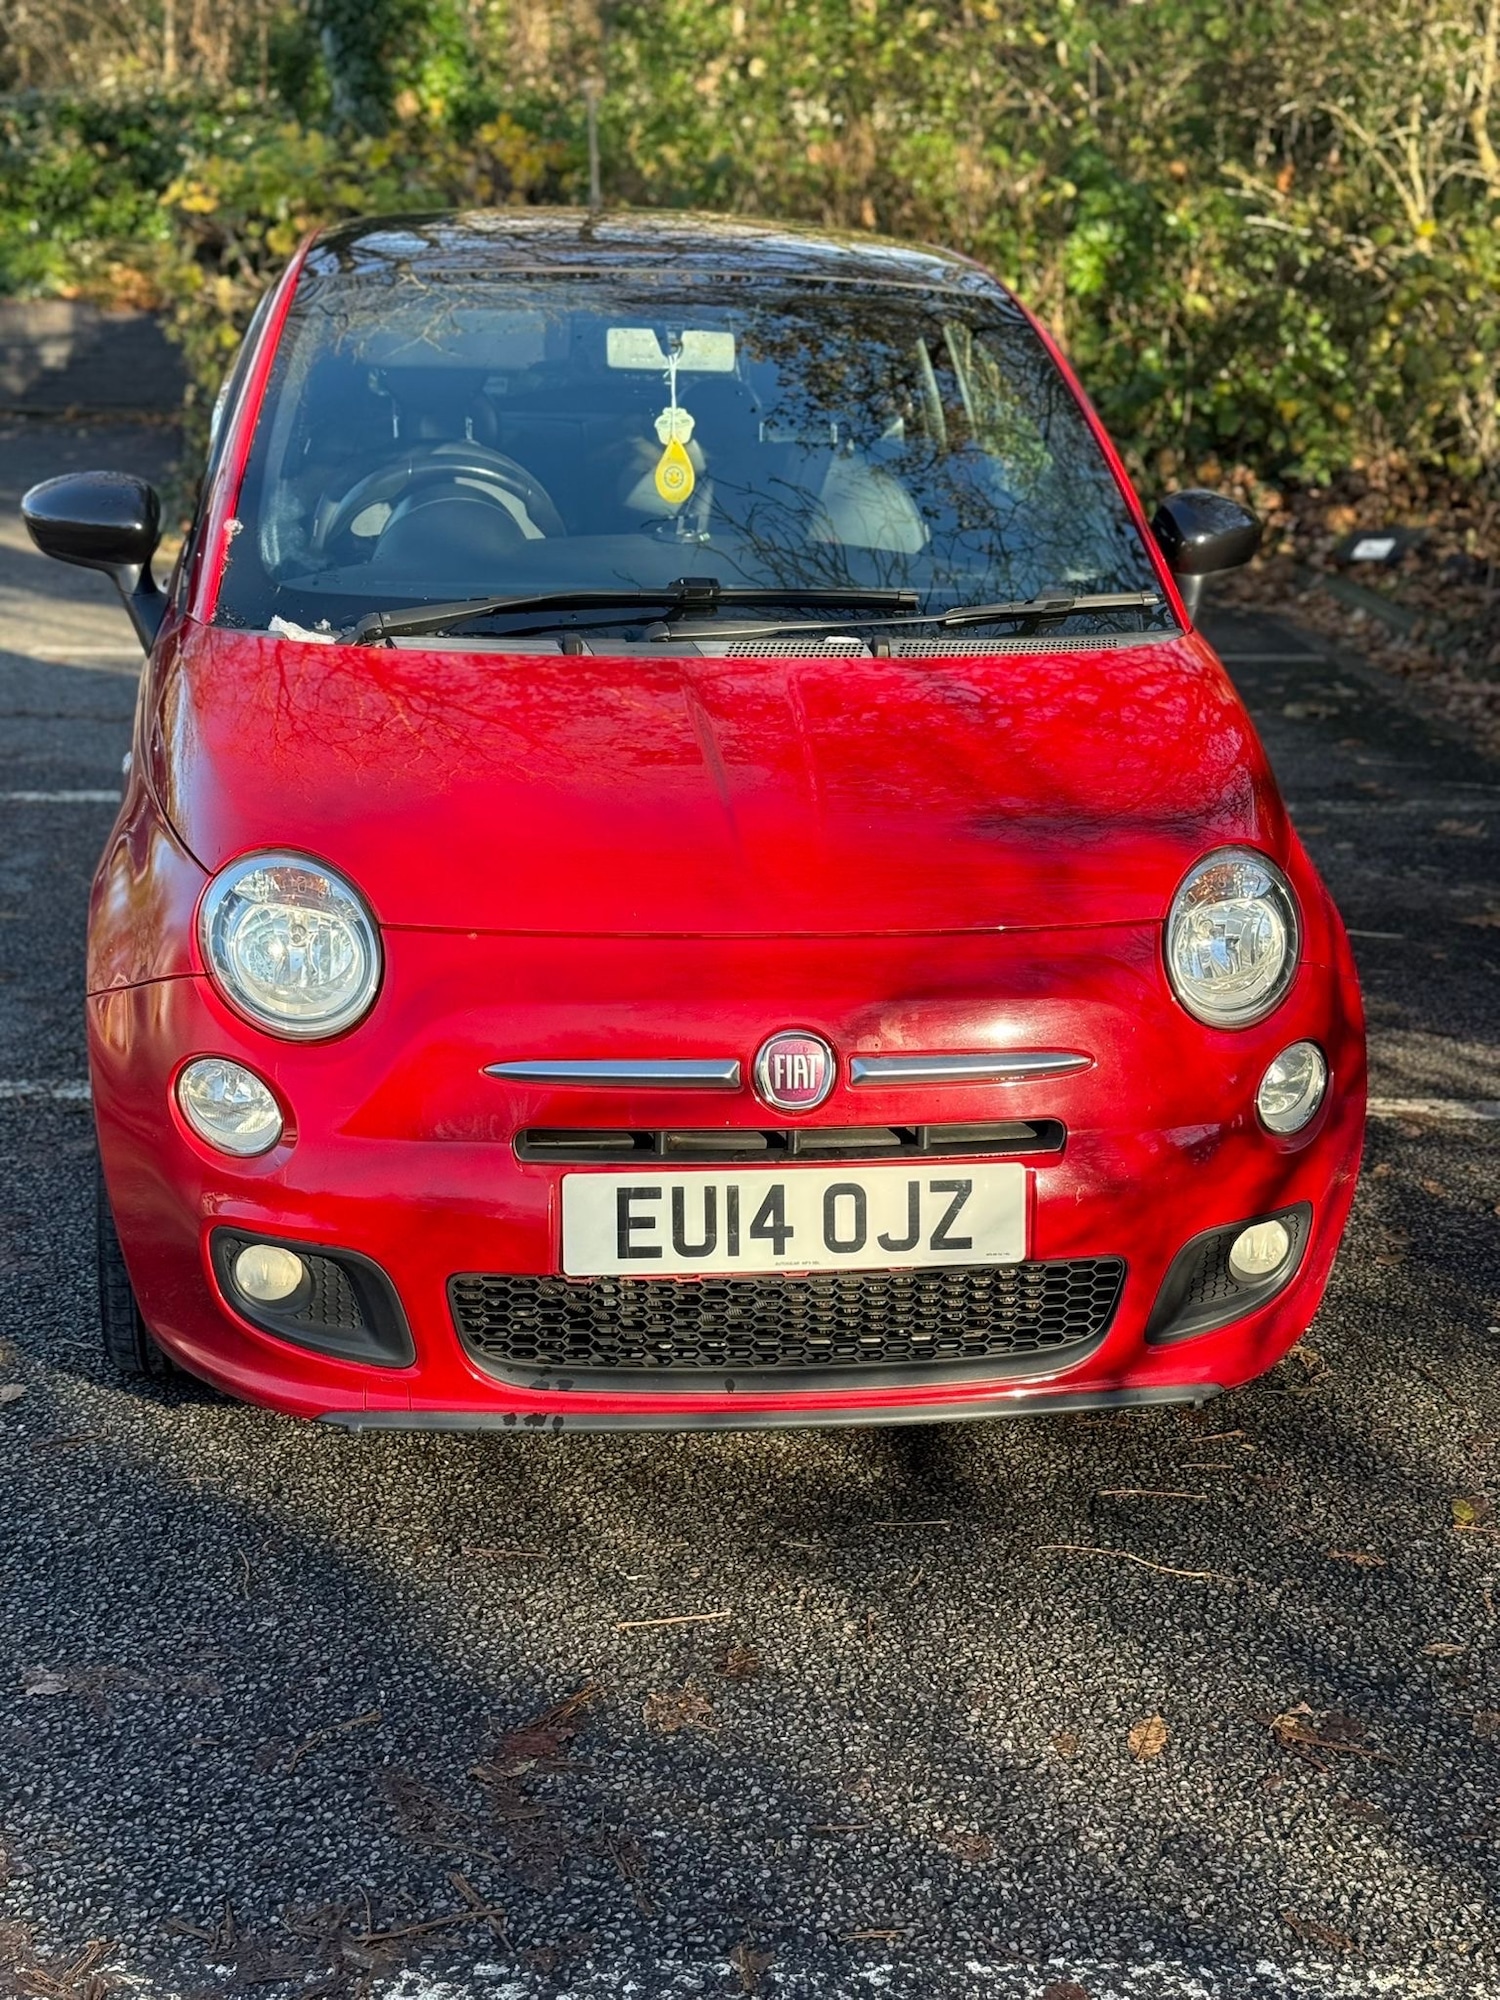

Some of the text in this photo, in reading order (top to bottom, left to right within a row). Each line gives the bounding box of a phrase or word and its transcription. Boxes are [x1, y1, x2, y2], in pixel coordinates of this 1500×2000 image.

[773, 1053, 820, 1090] FIAT
[616, 1179, 973, 1259] EU14 OJZ
